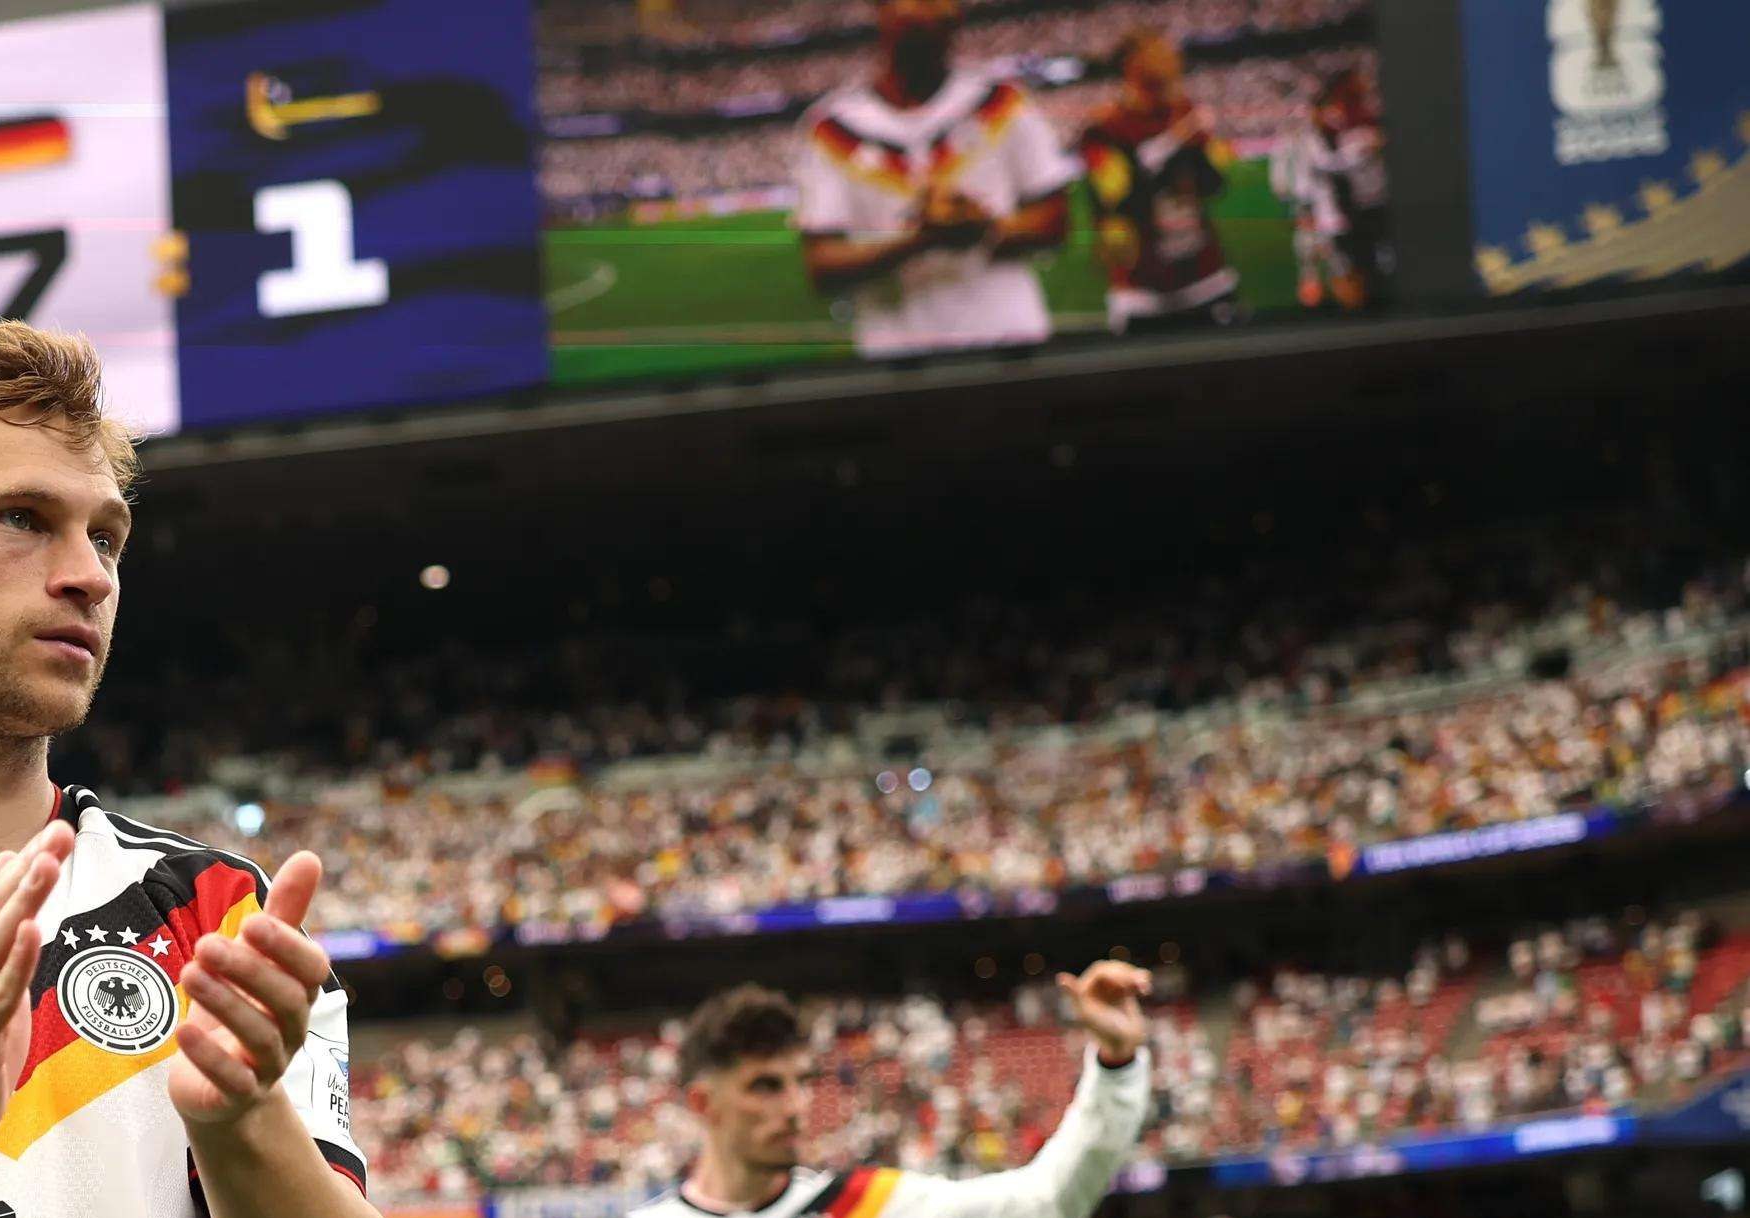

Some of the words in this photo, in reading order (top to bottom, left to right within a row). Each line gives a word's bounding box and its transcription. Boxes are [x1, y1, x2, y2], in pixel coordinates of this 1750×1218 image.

[253, 179, 388, 318] 1
[85, 961, 149, 982] DEUTSCHER
[81, 1004, 158, 1037] FUSSBALL-BUND
[330, 1093, 350, 1119] PEA
